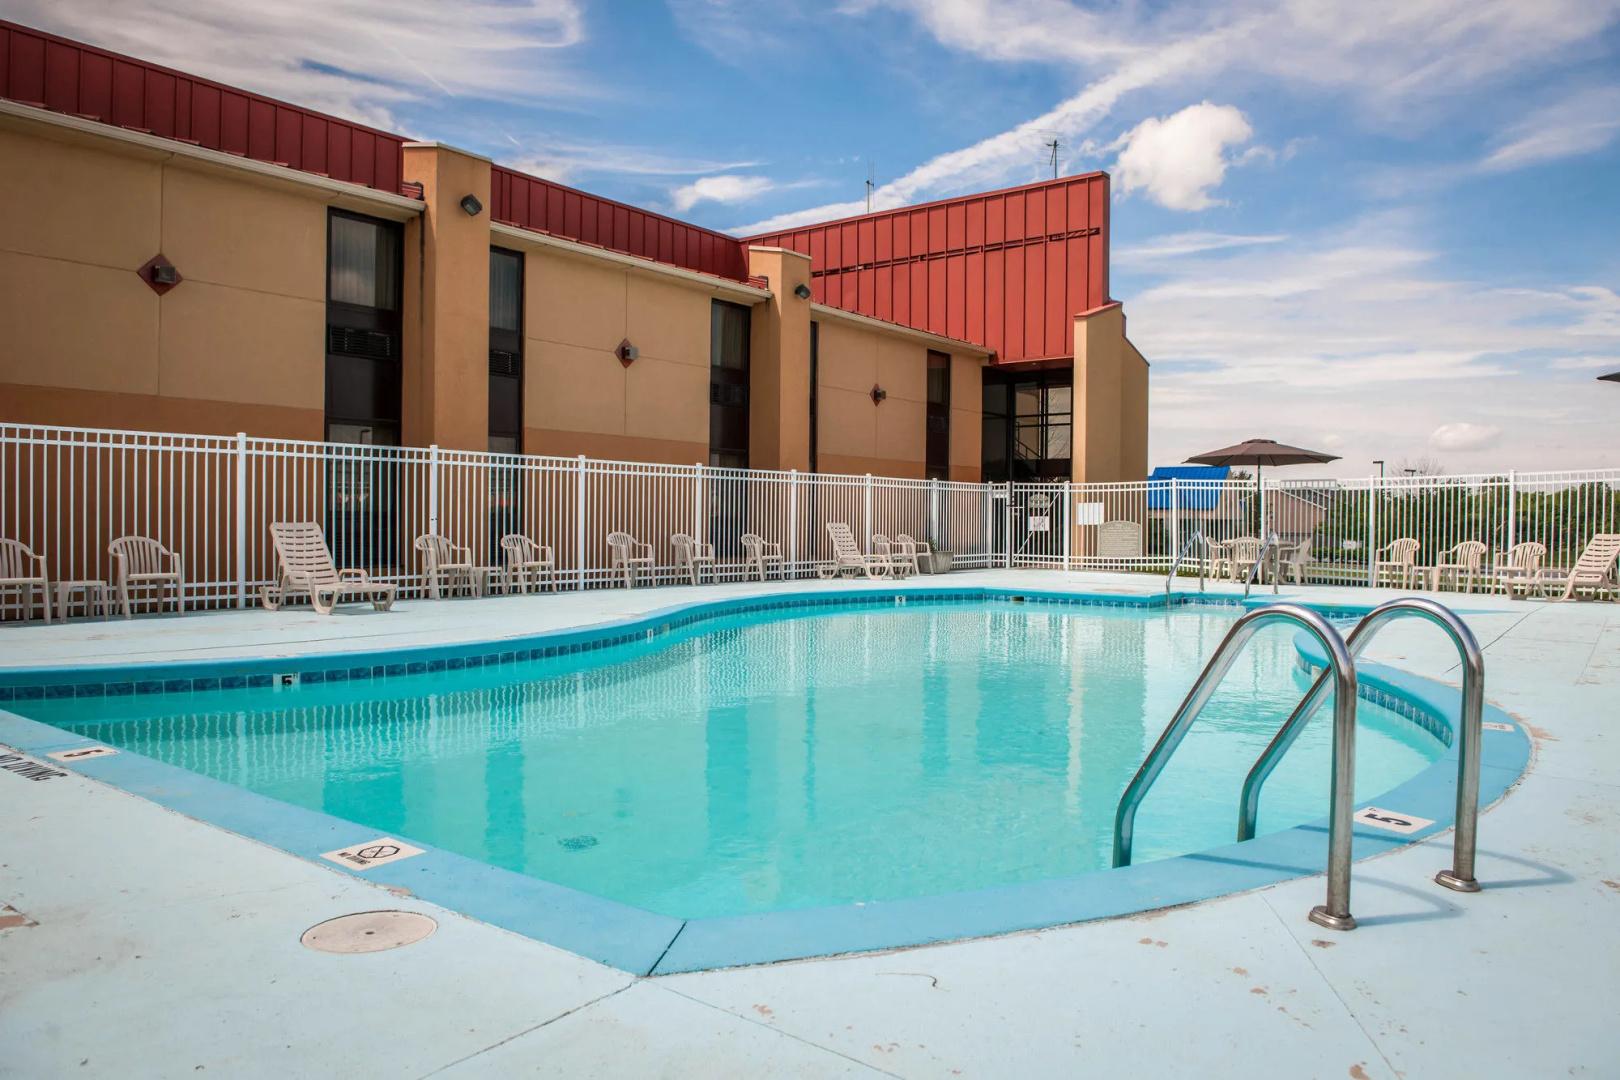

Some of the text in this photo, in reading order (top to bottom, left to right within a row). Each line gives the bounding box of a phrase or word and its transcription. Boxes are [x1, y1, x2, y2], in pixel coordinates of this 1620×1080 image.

[281, 675, 293, 686] 5
[1, 761, 68, 781] DIVING
[1364, 813, 1412, 826] 5
